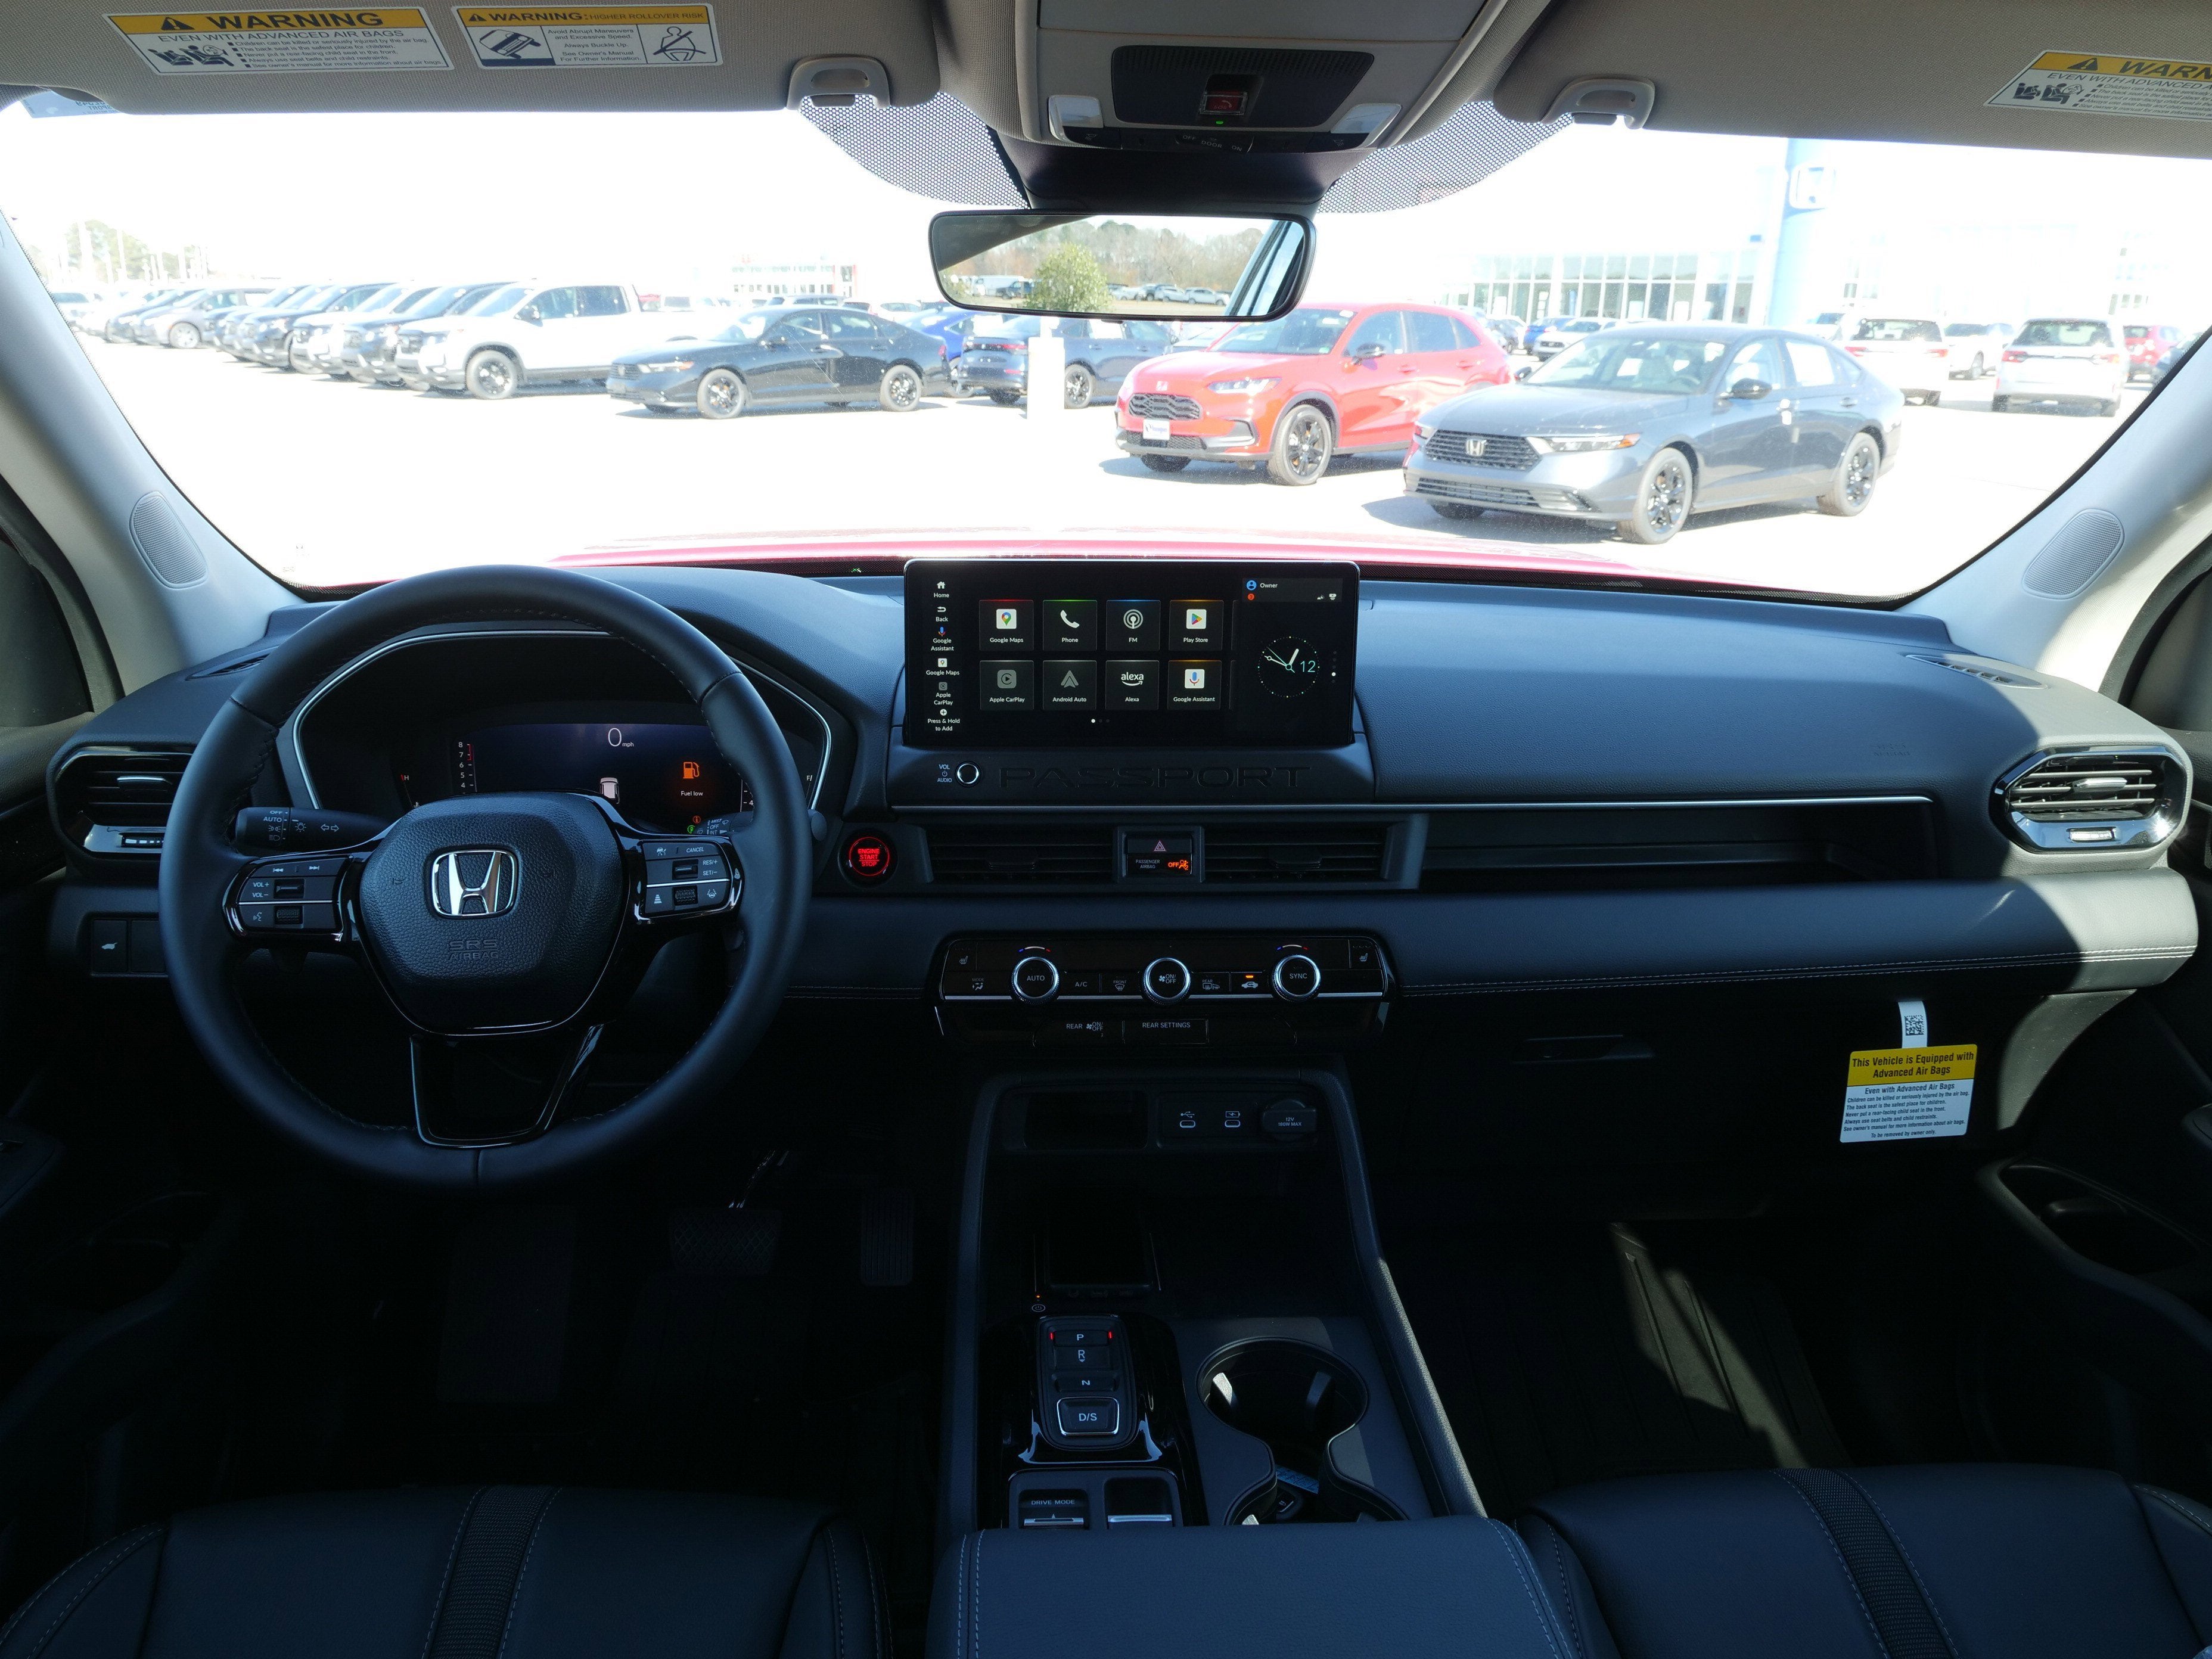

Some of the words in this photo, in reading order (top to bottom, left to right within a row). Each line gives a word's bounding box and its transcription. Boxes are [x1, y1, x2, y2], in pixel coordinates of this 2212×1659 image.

[205, 12, 383, 29] WARNING
[2089, 76, 2128, 84] WITH
[2125, 79, 2203, 89] ADVANCED
[1201, 140, 1222, 148] DOOR
[1300, 660, 1316, 673] 12
[1121, 672, 1144, 681] alexa
[608, 728, 622, 747] 0
[1000, 766, 1312, 787] PASSPORT
[449, 939, 497, 950] SRS
[449, 952, 498, 960] AIRBAG
[1853, 1058, 1870, 1067] This
[1873, 1057, 1903, 1066] Vehicle
[1916, 1053, 1954, 1064] Equipped
[1956, 1052, 1974, 1061] with
[1873, 1067, 1913, 1078] Advanced
[1916, 1067, 1927, 1075] Air
[1930, 1065, 1950, 1076] Bags
[1077, 1350, 1085, 1359] R
[1079, 1412, 1098, 1421] D/S
